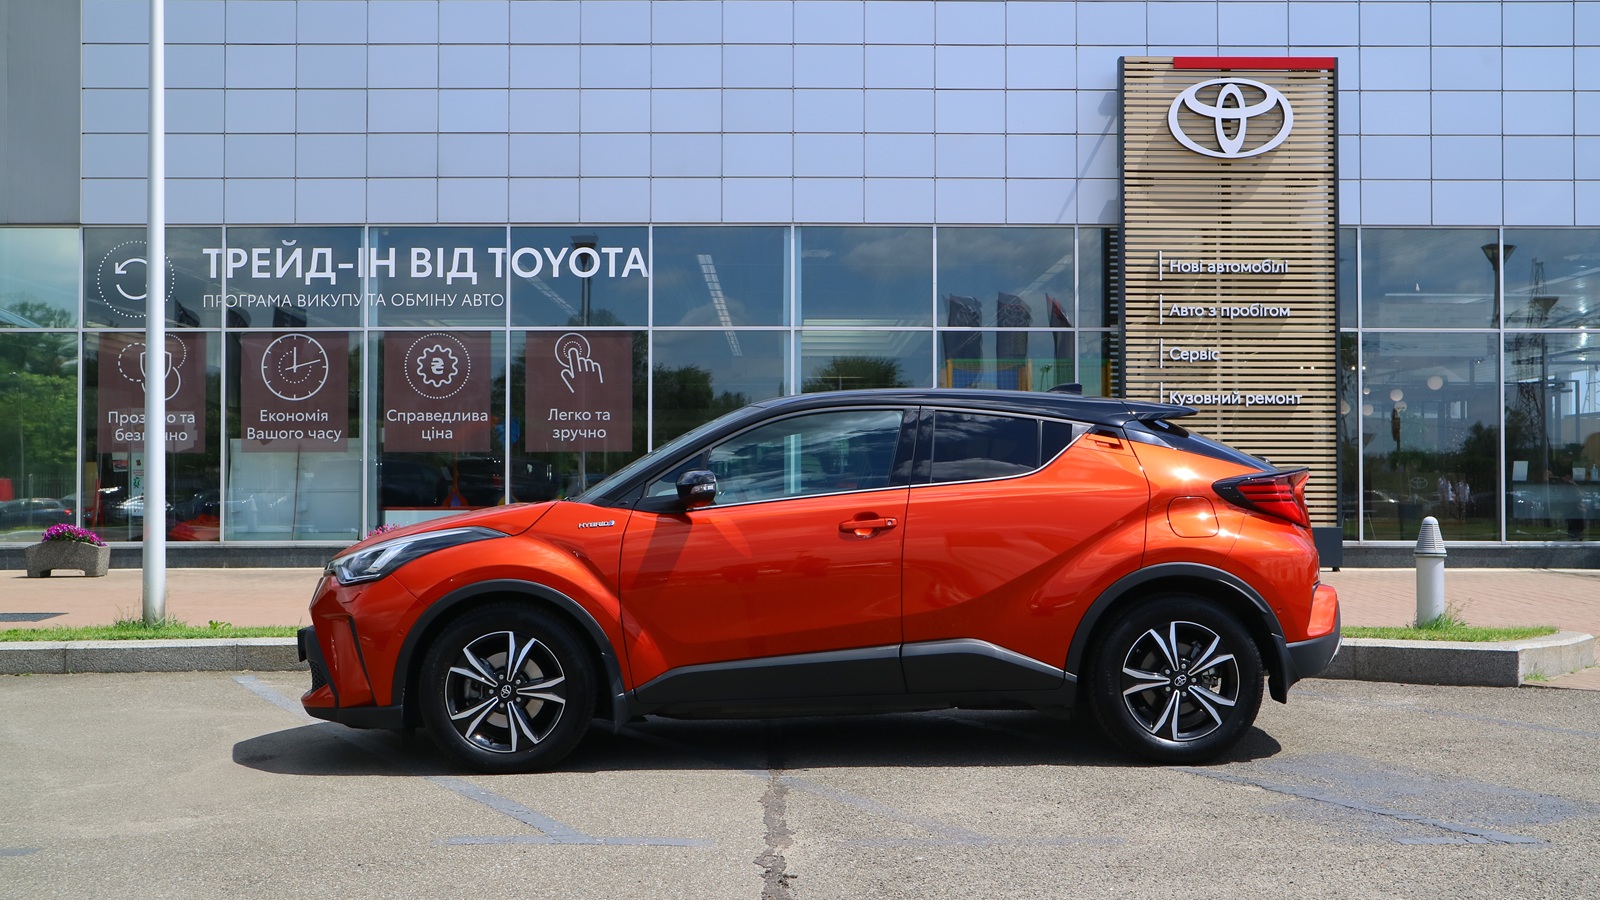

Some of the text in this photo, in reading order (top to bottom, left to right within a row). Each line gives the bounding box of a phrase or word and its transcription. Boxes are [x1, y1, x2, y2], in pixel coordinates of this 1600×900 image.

[202, 239, 649, 286] ТРЕЙД-ІН ВІД TOYOTA
[1169, 259, 1289, 273] Нові автомобілі
[203, 292, 505, 308] ПРОГРАМА ВИКУПУ ТА ОБМІНУ АВТО
[1169, 303, 1291, 320] Авто з пробігом
[1169, 347, 1220, 363] Сервіс
[1169, 391, 1302, 408] Кузовний ремонт
[108, 411, 195, 426] Прозо та
[259, 408, 329, 422] Економія
[386, 409, 489, 424] Справедлива
[547, 408, 611, 422] Легко та
[115, 428, 188, 441] безно
[246, 427, 343, 443] Вашого часу
[421, 426, 453, 441] ціна
[552, 428, 607, 442] зручно
[578, 521, 609, 529] HYBRID
